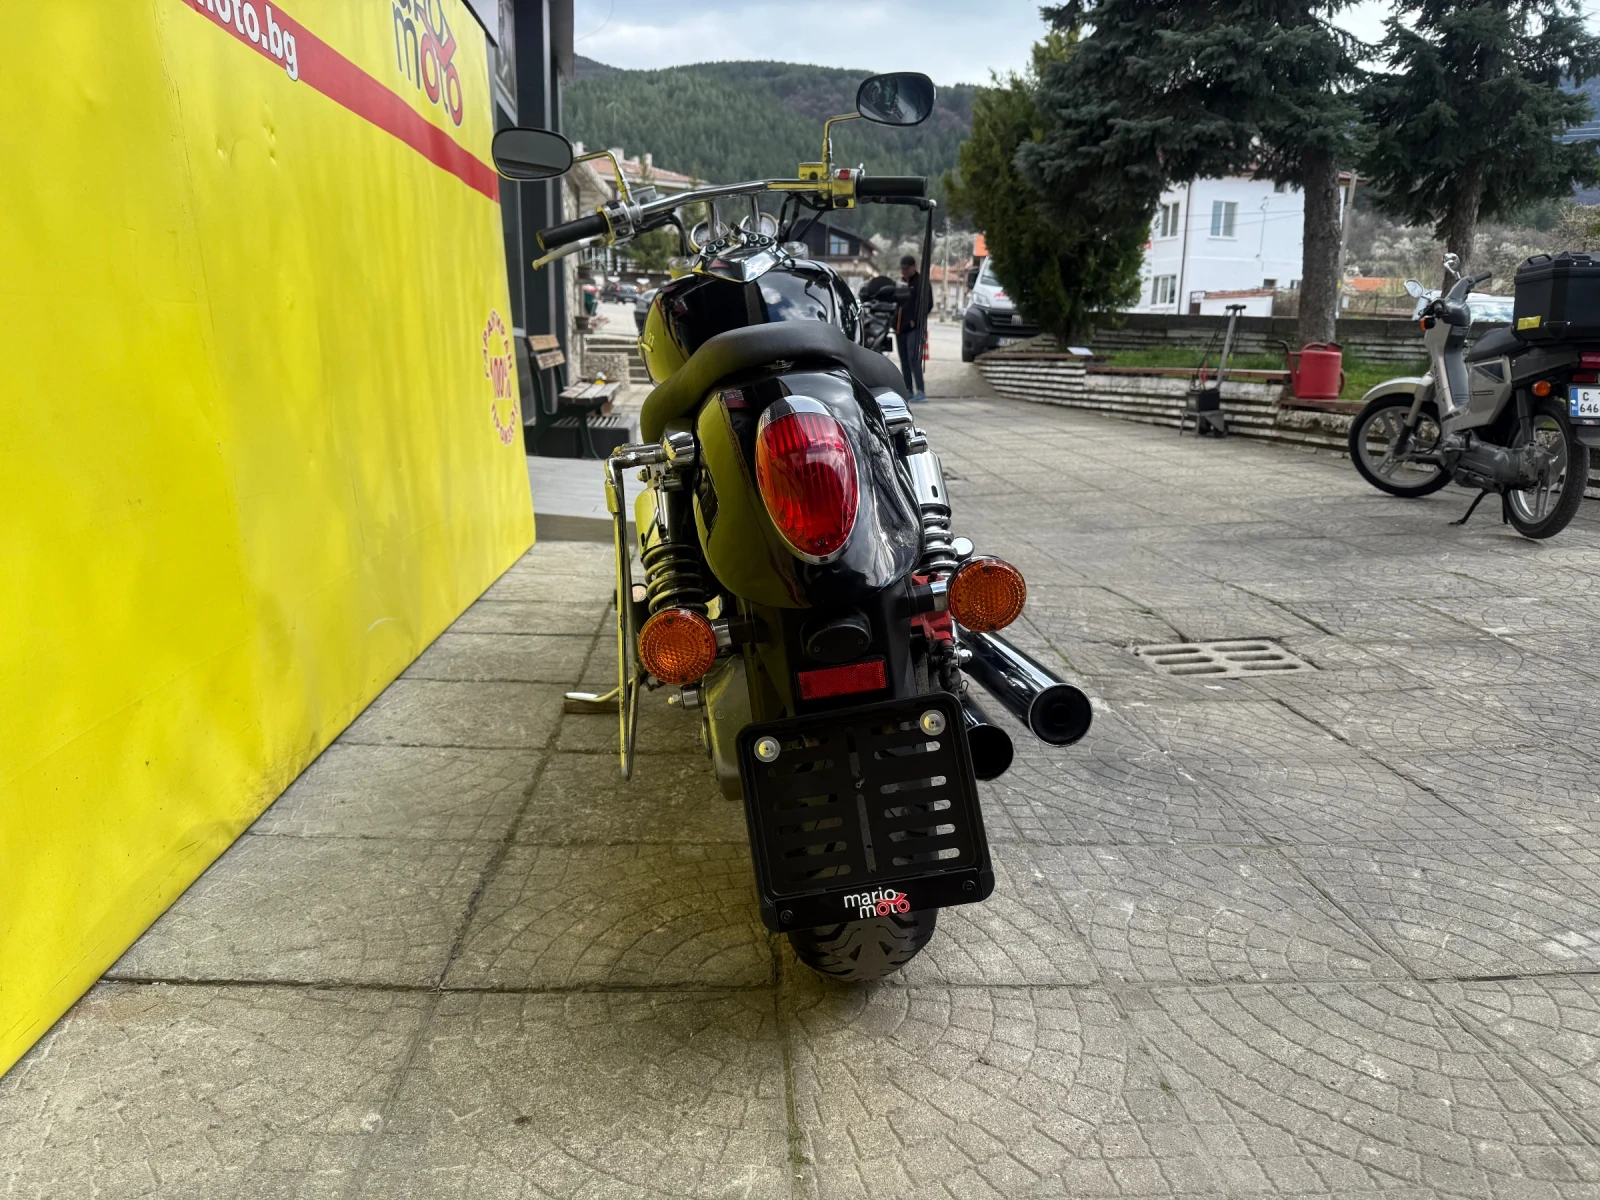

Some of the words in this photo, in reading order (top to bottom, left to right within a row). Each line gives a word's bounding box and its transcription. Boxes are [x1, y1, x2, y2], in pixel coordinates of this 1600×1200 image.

[196, 0, 298, 81] oto.bg
[1583, 391, 1590, 401] C
[1580, 403, 1599, 413] 646
[843, 887, 897, 909] mario
[859, 900, 911, 918] moto
